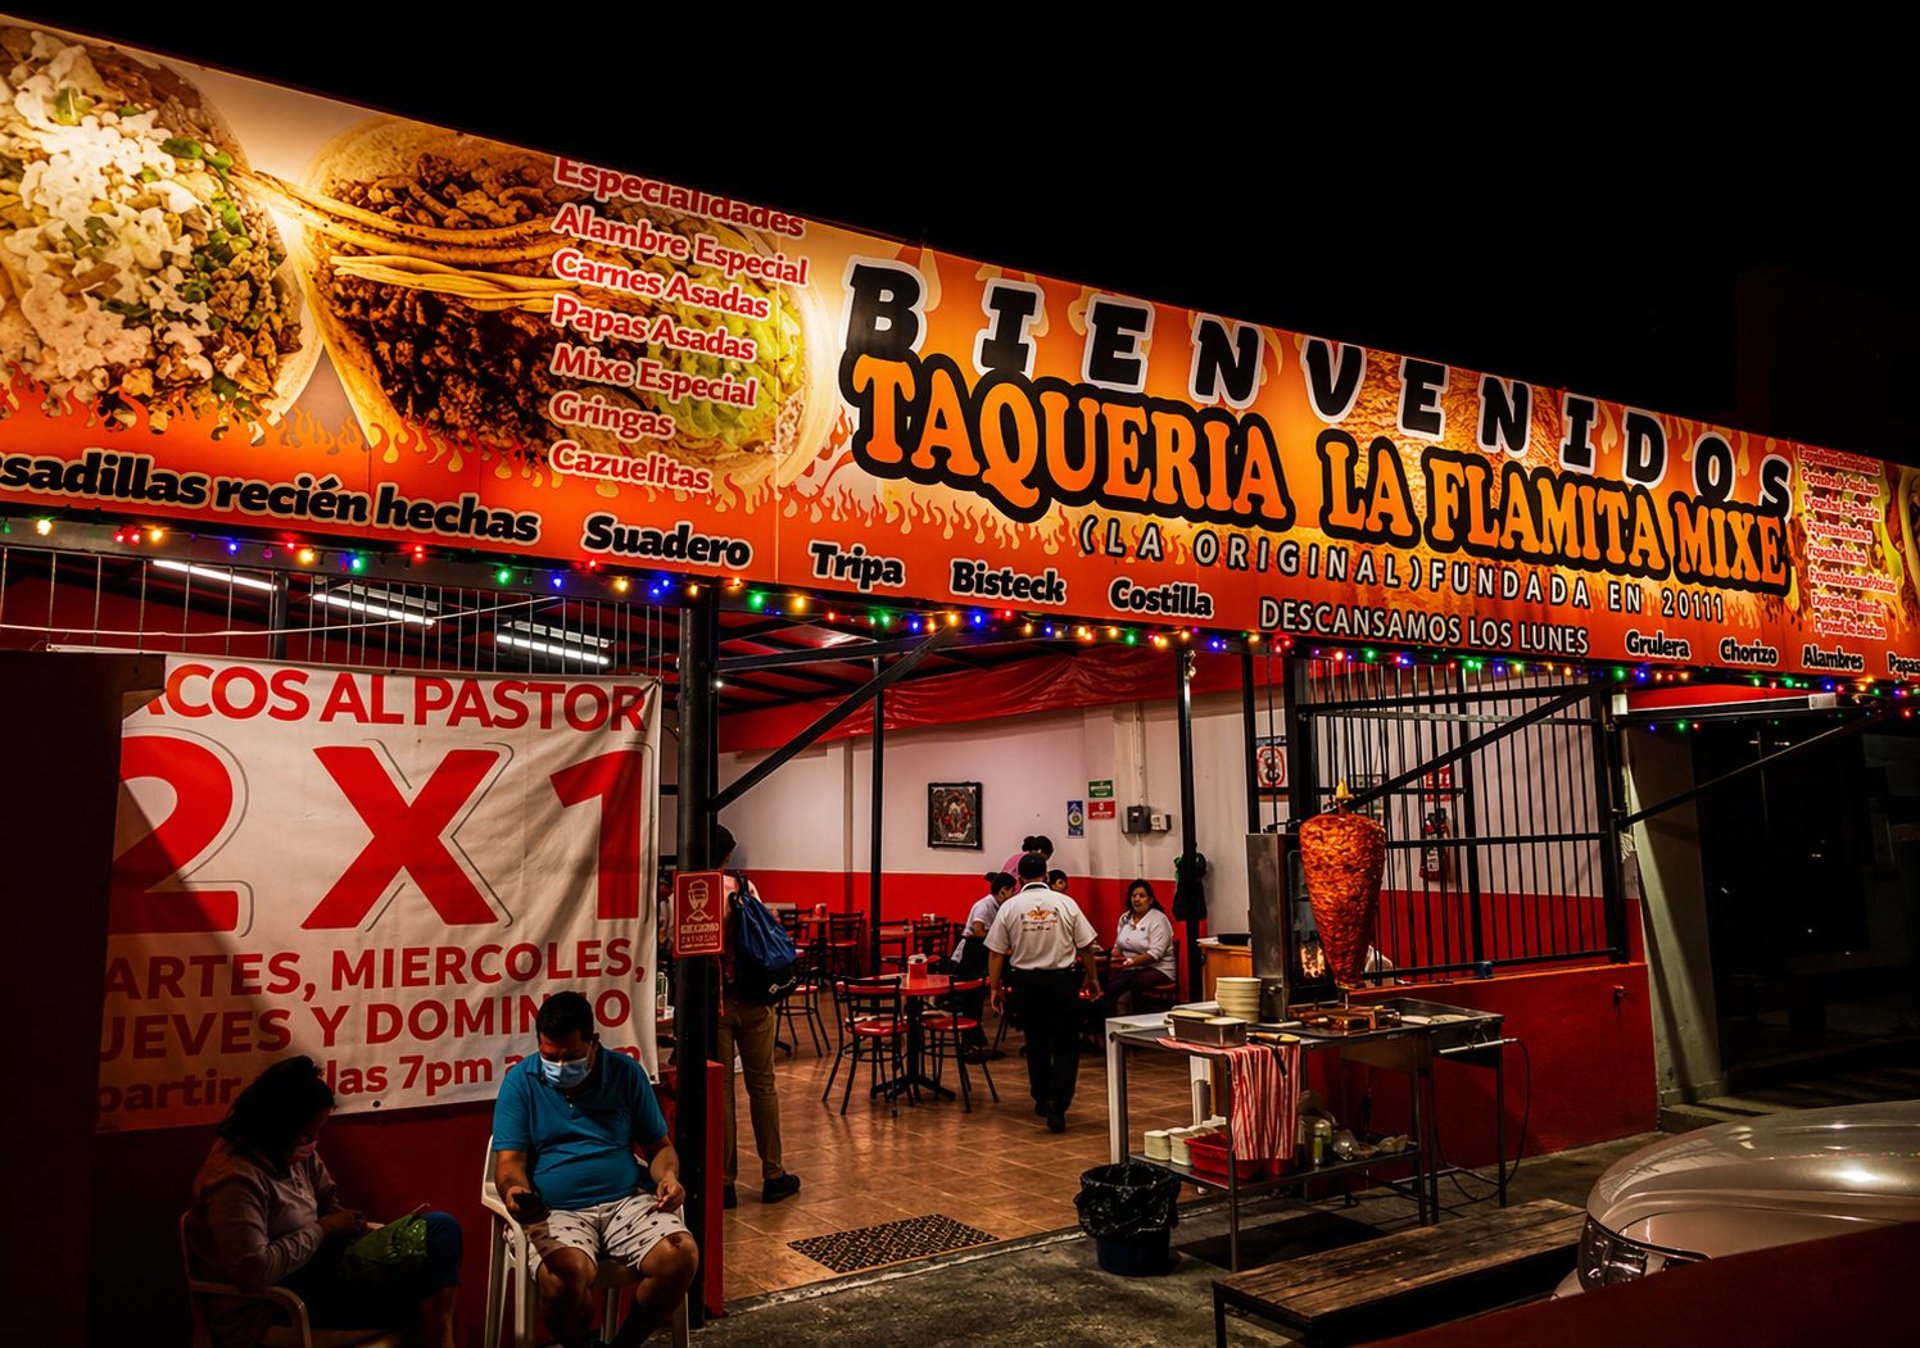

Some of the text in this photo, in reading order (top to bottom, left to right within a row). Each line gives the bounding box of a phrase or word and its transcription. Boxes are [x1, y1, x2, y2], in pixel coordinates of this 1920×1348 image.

[556, 158, 805, 236] Especialidades
[555, 206, 807, 285] Alambre Especial
[555, 252, 769, 319] Carnes Asadas
[555, 298, 755, 361] Papas Asadas
[553, 346, 757, 406] Mixe Especial
[552, 393, 673, 439] Gringas
[552, 444, 711, 490] Cazuelitas
[849, 350, 1788, 587] TAQUERIA LA FLAMITA MIXE
[0, 451, 539, 543] sadillas recién hechas
[584, 516, 751, 568] Suadero
[811, 542, 904, 592] Tripa
[952, 561, 1065, 606] Bisteck
[1110, 579, 1214, 619] Costilla
[1609, 581, 1641, 613] EN
[1662, 588, 1723, 623] 20111
[1260, 599, 1590, 656] DESCANSAMOS LOS LUNES
[1626, 630, 1690, 658] Grulera
[1720, 638, 1778, 665] Chorizo
[1802, 646, 1863, 671] Alambres
[148, 664, 647, 732] COS AL PASTOR
[331, 938, 645, 991] MIERCOLES,
[310, 1005, 350, 1047] Y
[366, 988, 632, 1044] DOMINO
[326, 1059, 388, 1096] las
[400, 1055, 493, 1097] 7pm
